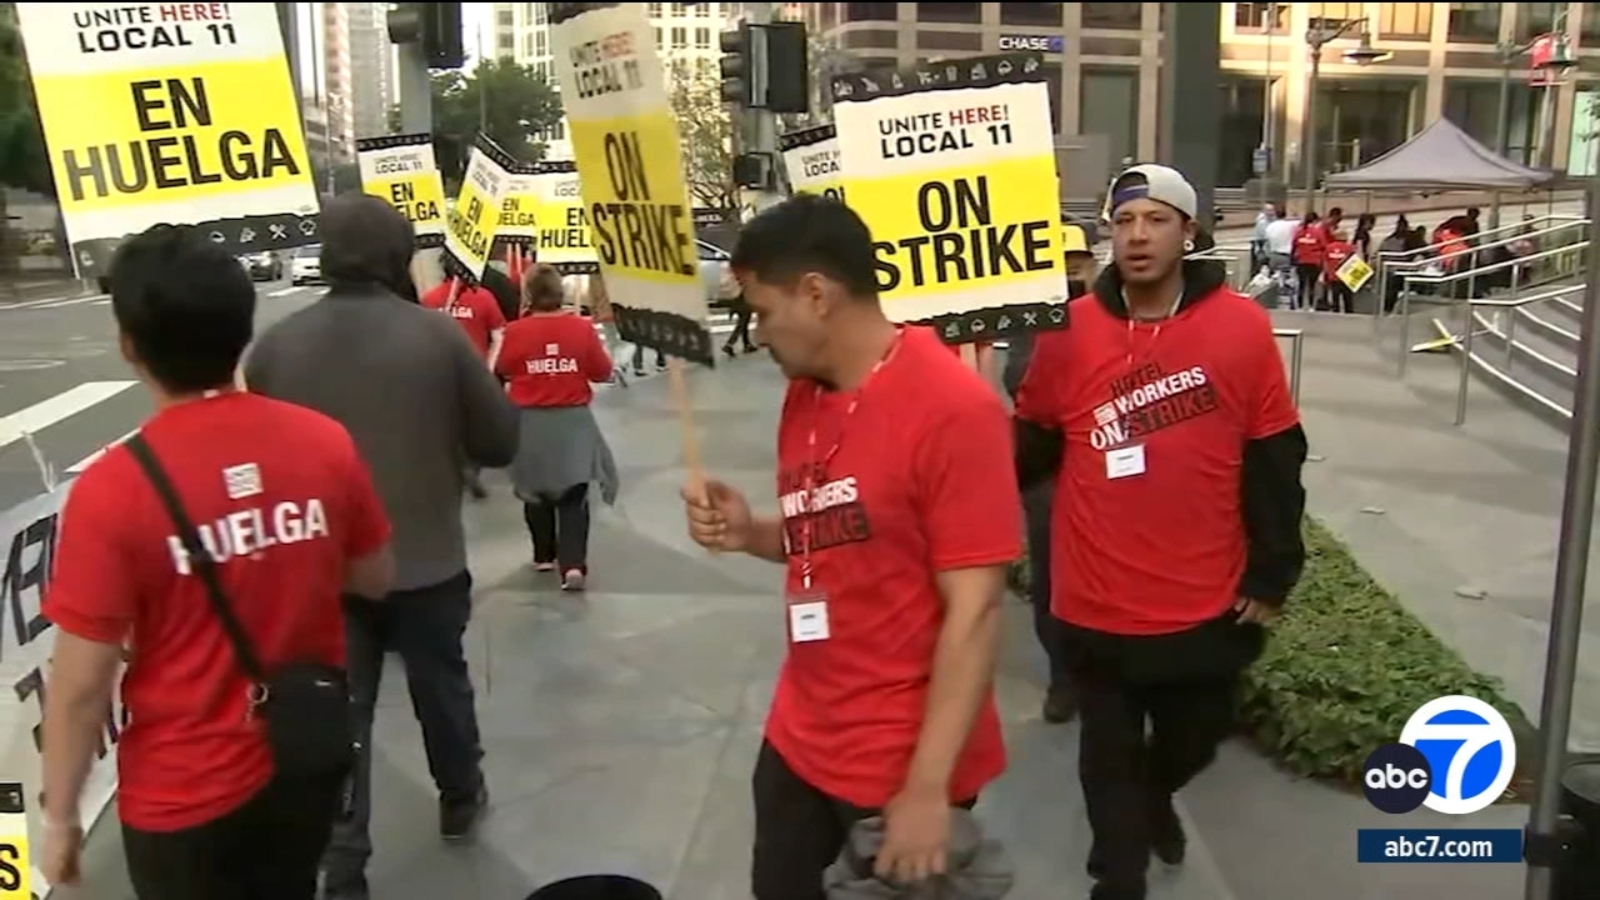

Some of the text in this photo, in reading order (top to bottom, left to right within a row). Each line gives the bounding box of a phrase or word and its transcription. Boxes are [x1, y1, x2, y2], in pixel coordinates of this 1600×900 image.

[74, 2, 233, 28] UNITE HERE!
[78, 23, 237, 53] LOCAL 11
[999, 37, 1048, 49] CHASE
[130, 77, 212, 132] EN
[879, 104, 1010, 136] UNITE HERE!
[881, 124, 1013, 159] LOCAL 11
[63, 128, 300, 201] HUELGA
[376, 162, 409, 174] LOCAL
[604, 131, 650, 201] ON
[805, 161, 840, 177] LOCA
[391, 182, 414, 202] EN
[502, 198, 520, 211] EN
[918, 175, 991, 233] ON
[395, 201, 440, 222] ELGA
[467, 196, 484, 225] EN
[541, 228, 594, 248] HUEL
[592, 203, 695, 276] STRIKE
[872, 220, 1054, 293] STRIKE
[526, 358, 578, 374] HUELGA
[1115, 366, 1207, 414] WORKERS
[1090, 420, 1125, 450] ON
[1131, 386, 1216, 437] STRIKE
